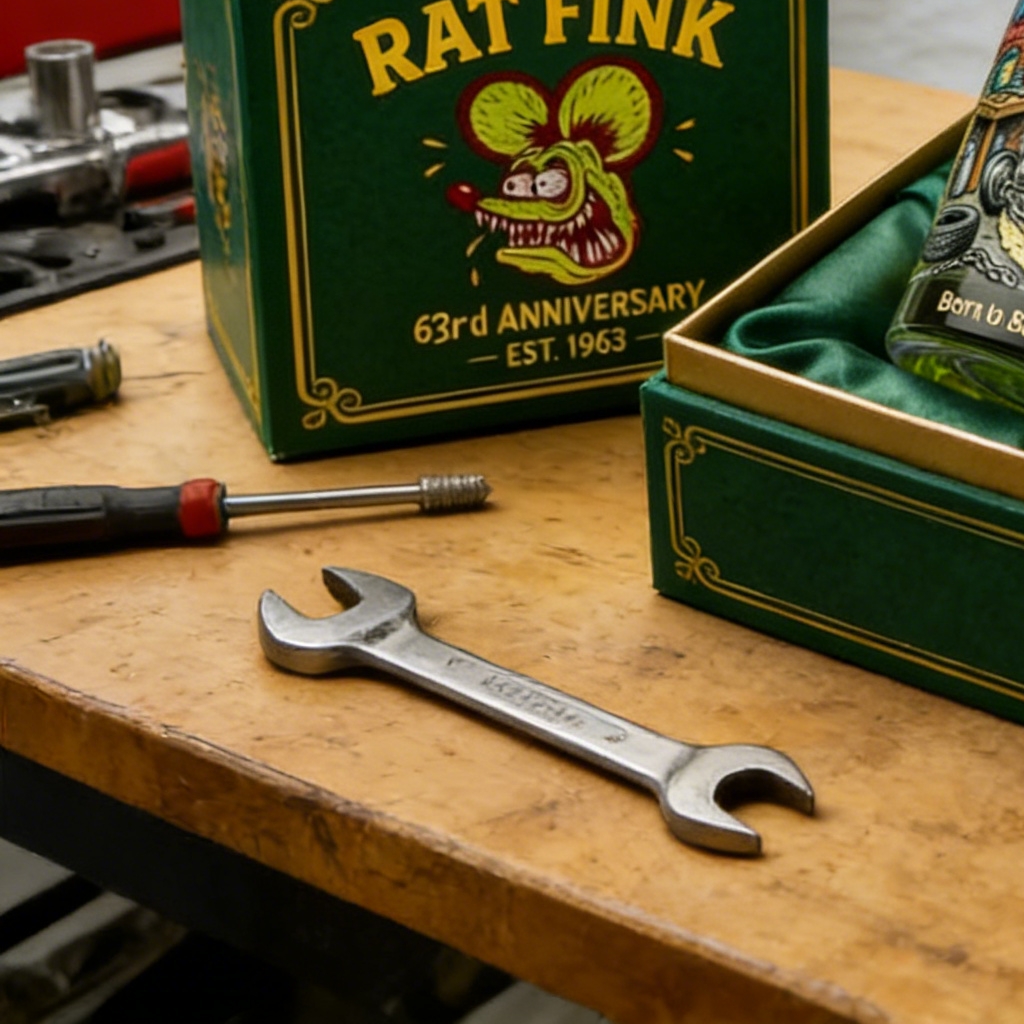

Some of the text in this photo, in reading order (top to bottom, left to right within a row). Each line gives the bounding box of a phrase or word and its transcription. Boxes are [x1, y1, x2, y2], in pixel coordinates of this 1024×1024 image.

[413, 279, 705, 345] 63rd ANNIVERSARY
[506, 327, 626, 368] EST. 1963
